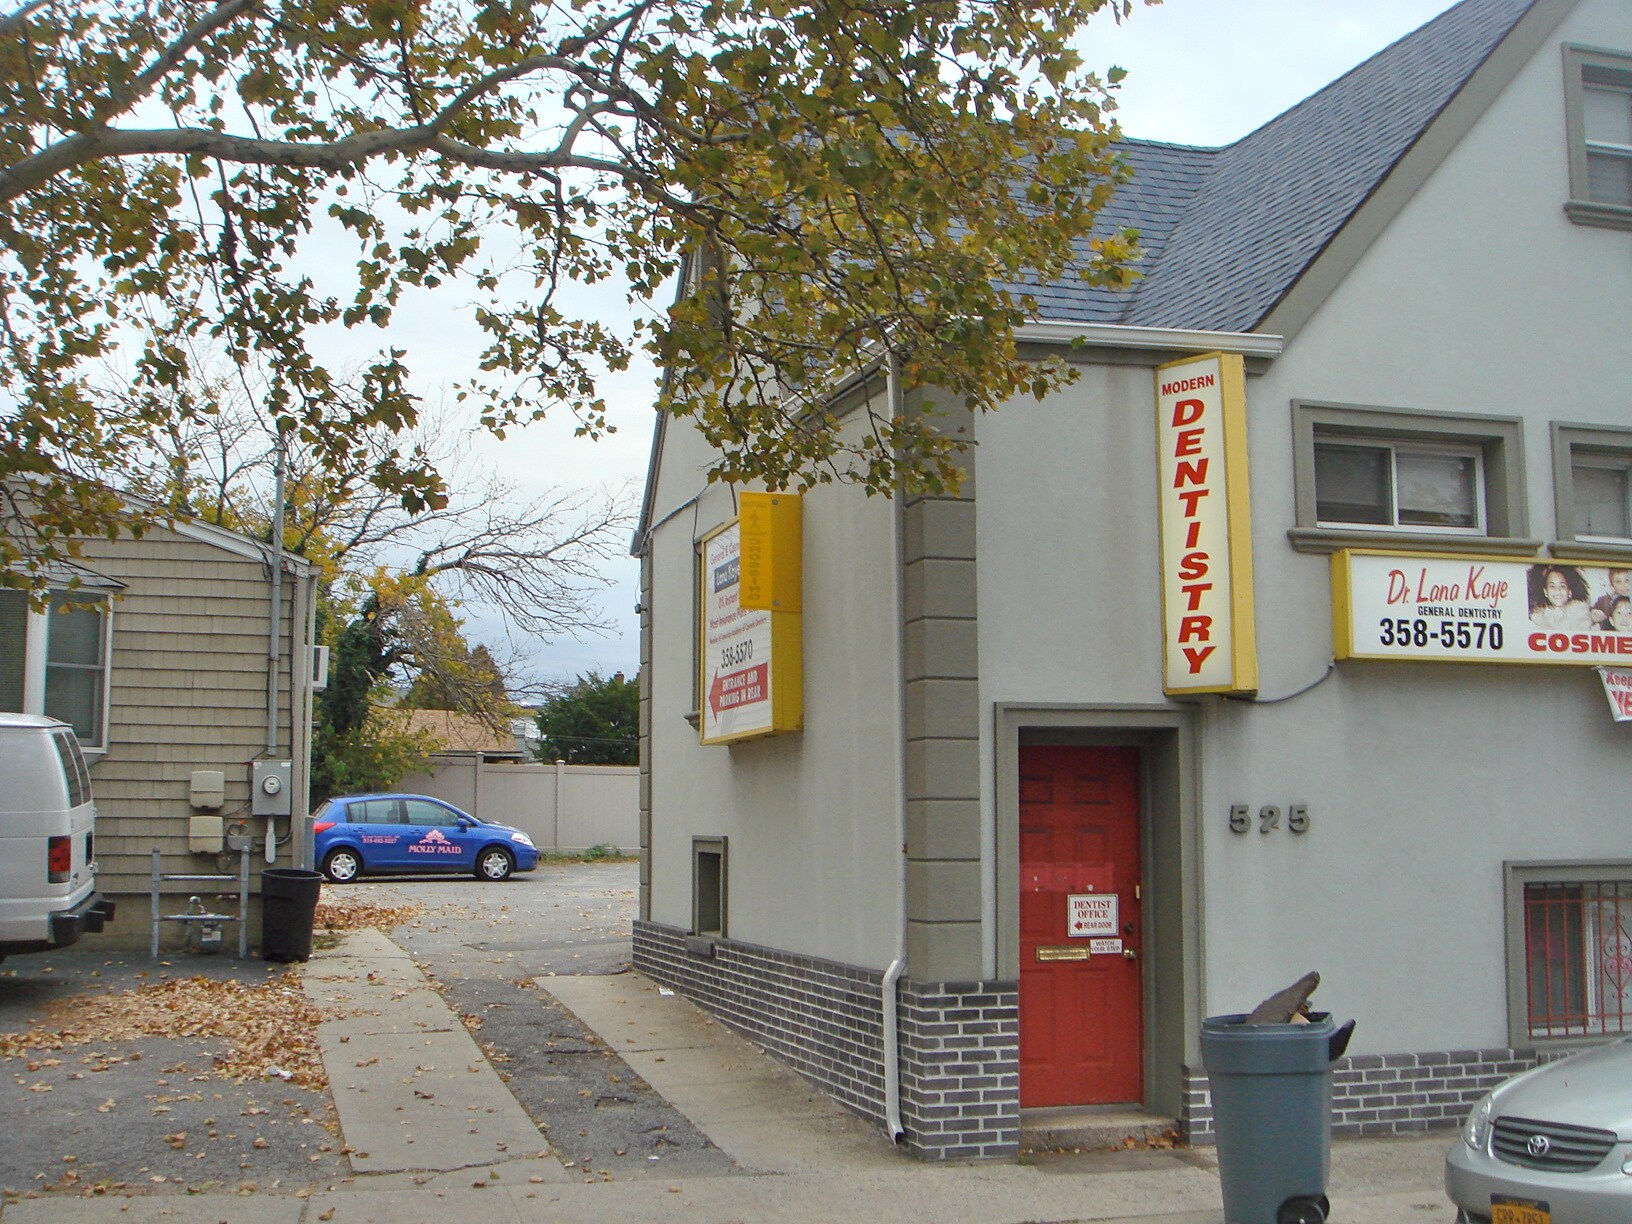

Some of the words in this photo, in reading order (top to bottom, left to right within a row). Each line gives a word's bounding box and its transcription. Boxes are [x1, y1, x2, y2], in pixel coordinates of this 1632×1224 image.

[1162, 374, 1215, 396] MODERN
[1171, 398, 1217, 674] DENTISTRY
[1387, 569, 1411, 605] Dr.
[1416, 567, 1460, 603] Lana
[1465, 565, 1508, 609] Kaye
[1417, 605, 1455, 617] GENERAL
[1458, 607, 1502, 619] DENTISTRY
[1380, 617, 1503, 650] 358-5570
[721, 638, 754, 669] 358-5570
[1229, 804, 1310, 834] 525
[409, 845, 436, 853] MOLLY
[437, 846, 462, 854] MAID
[1074, 900, 1111, 909] DENTIST
[1078, 910, 1108, 919] OFFICE
